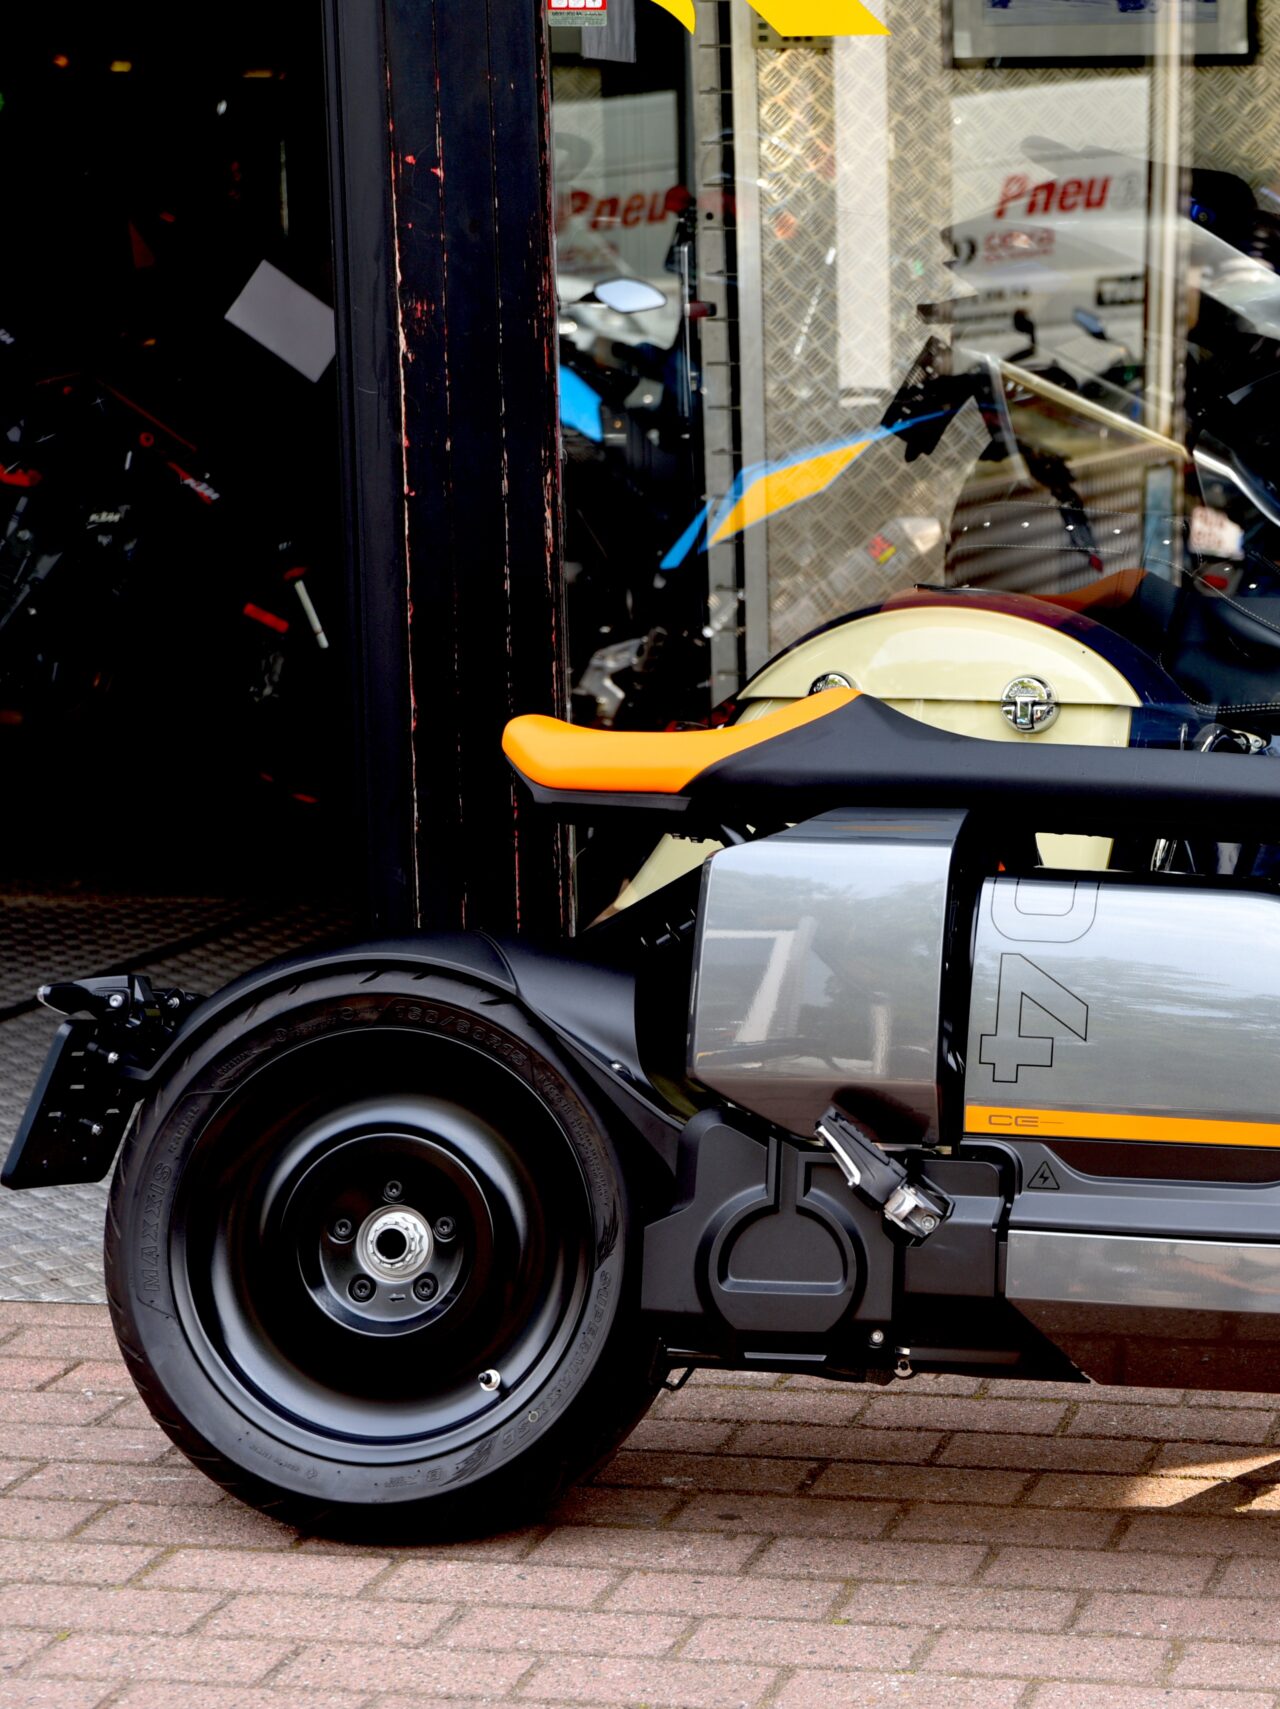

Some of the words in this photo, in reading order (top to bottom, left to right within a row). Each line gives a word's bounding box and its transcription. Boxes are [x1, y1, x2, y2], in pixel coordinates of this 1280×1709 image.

[994, 173, 1113, 220] Pneu
[988, 1114, 1039, 1128] CE
[141, 1162, 172, 1292] MAXXIS
